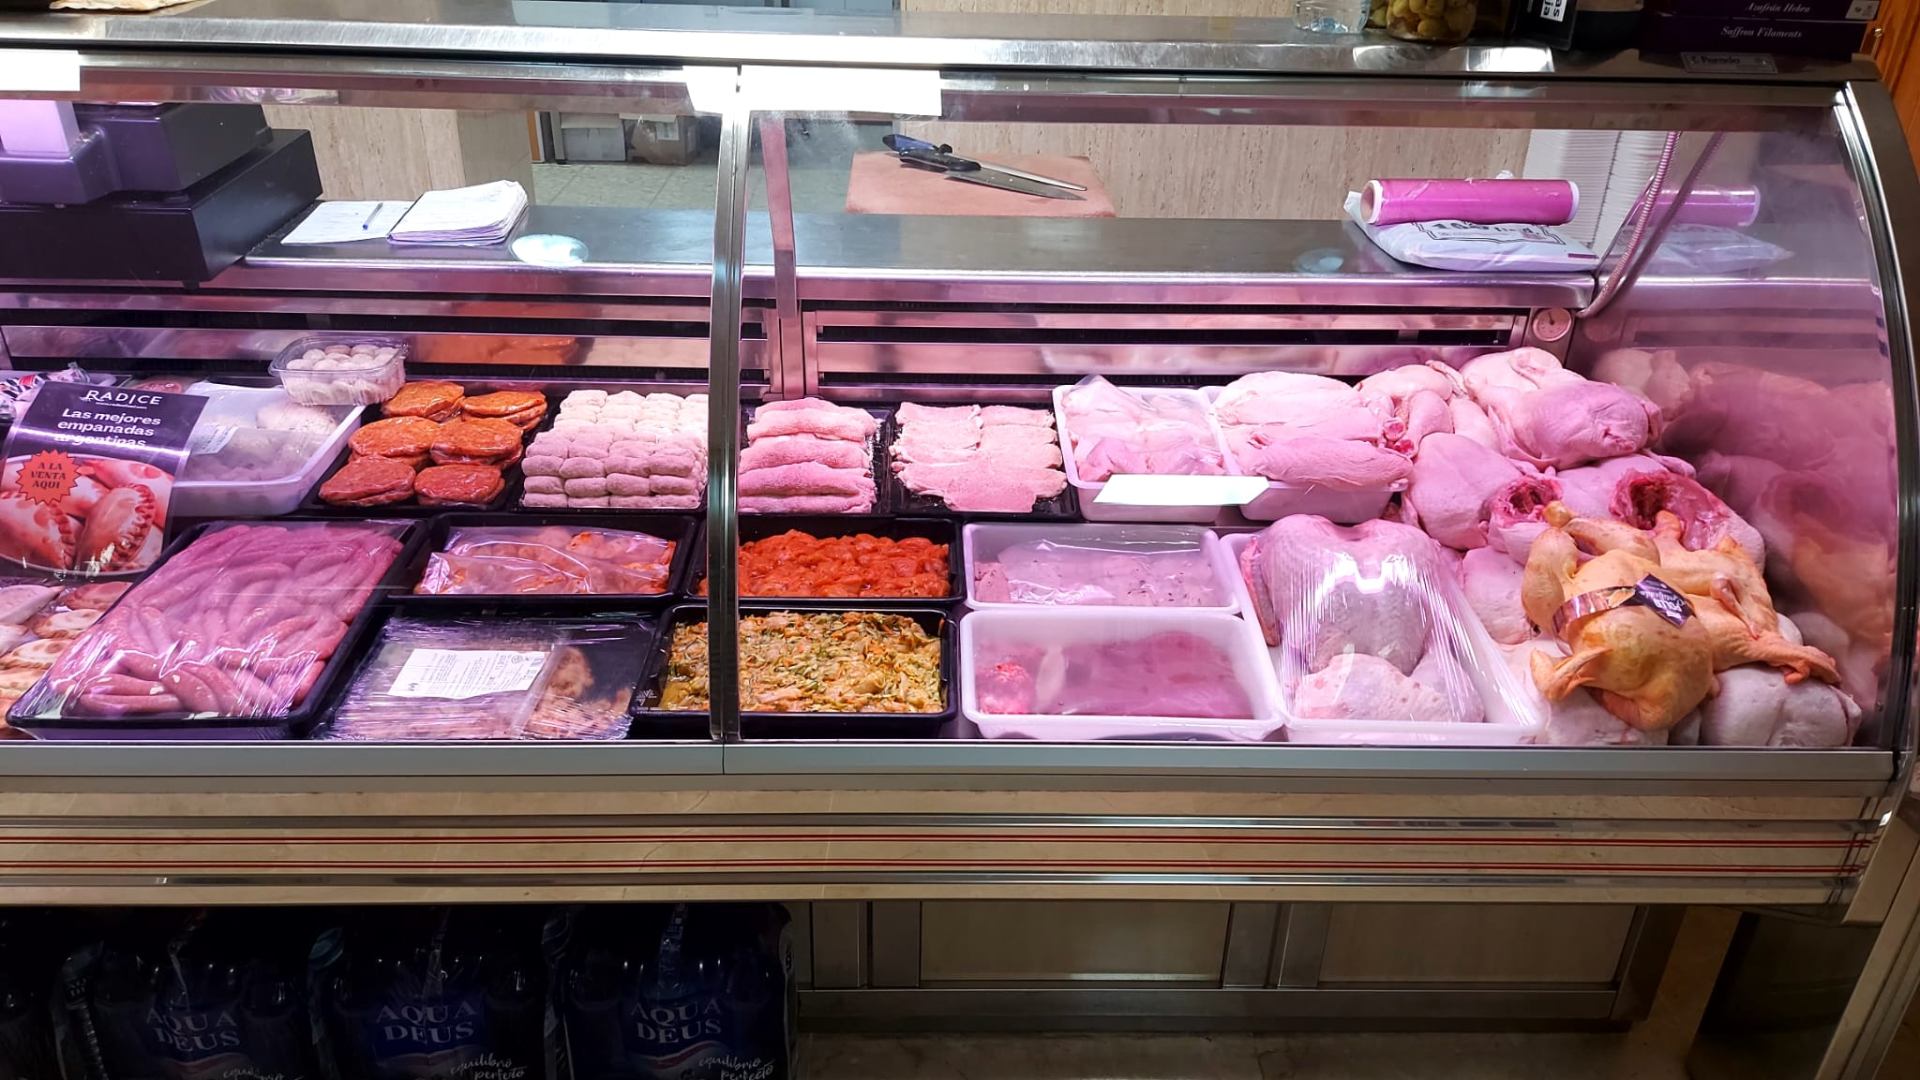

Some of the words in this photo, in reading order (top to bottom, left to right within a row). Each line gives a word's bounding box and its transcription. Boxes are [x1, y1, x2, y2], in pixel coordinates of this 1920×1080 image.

[1720, 25, 1755, 38] Saffron
[1757, 26, 1803, 38] Filaments
[80, 389, 163, 405] RADICE
[62, 408, 92, 420] Las
[93, 412, 162, 426] mejores
[57, 421, 155, 437] empanadas
[31, 470, 66, 480] VENTA
[38, 462, 45, 470] A
[48, 462, 63, 470] LA
[146, 1007, 238, 1035] AQUA
[376, 999, 479, 1025] AQUA
[630, 997, 722, 1027] AQUA
[384, 1020, 475, 1045] DEUS
[635, 1017, 723, 1043] DEUS
